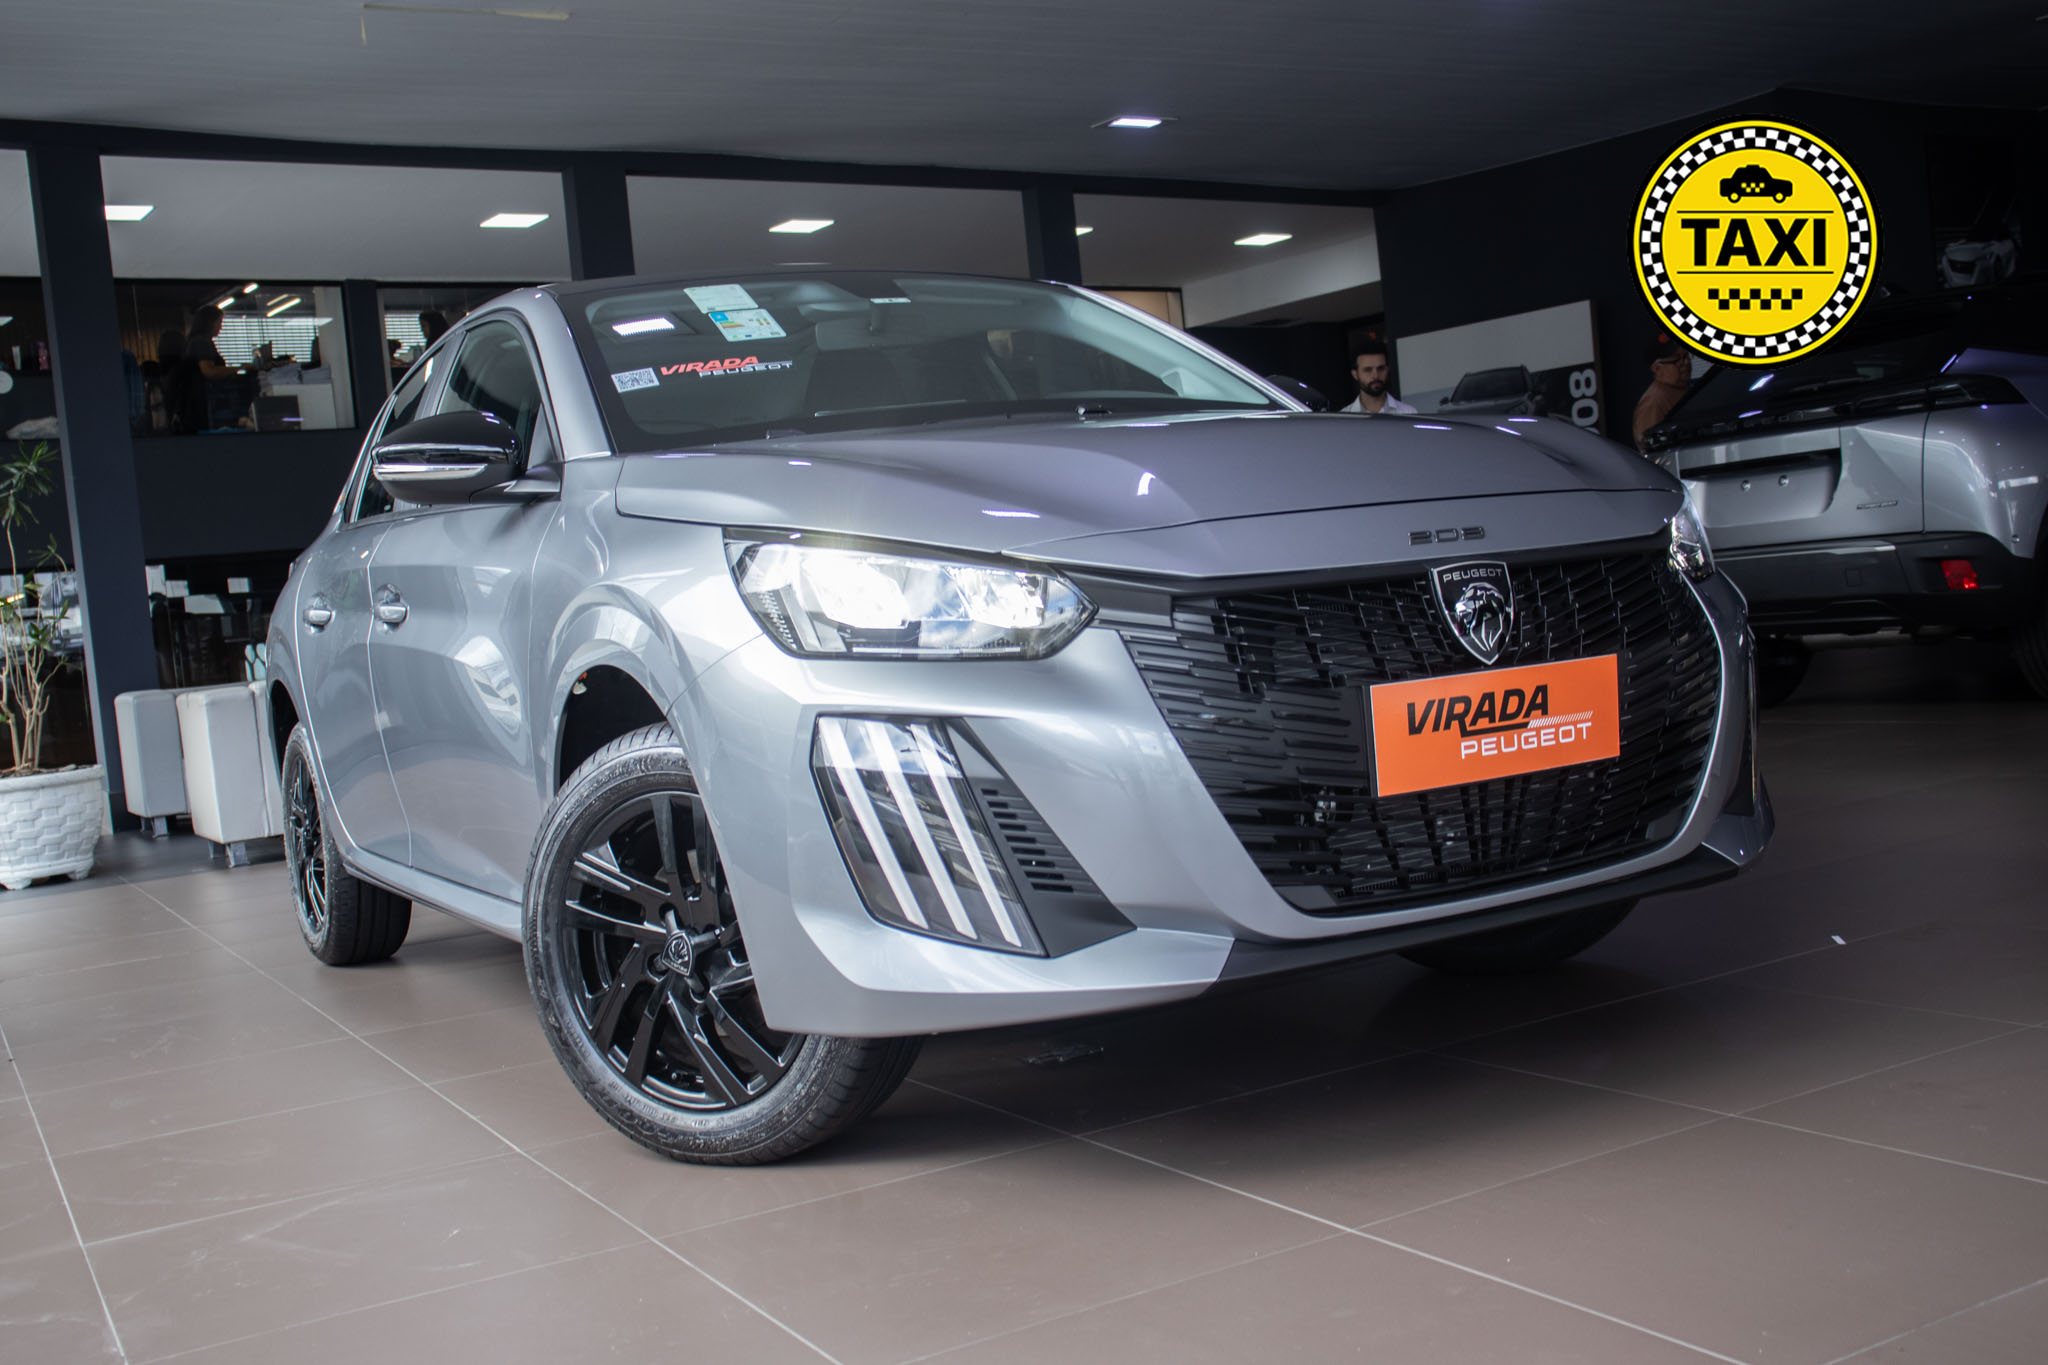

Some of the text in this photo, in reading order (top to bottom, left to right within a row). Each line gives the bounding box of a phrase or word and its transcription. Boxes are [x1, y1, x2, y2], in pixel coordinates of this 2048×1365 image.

[660, 355, 759, 376] VIRADA
[699, 362, 792, 378] PEUGEOT
[1568, 368, 1600, 434] 08
[1407, 526, 1486, 546] 208
[1442, 568, 1503, 583] PEUGEOT
[1406, 684, 1549, 738] VIRADA
[1460, 721, 1593, 760] PEUGEOT
